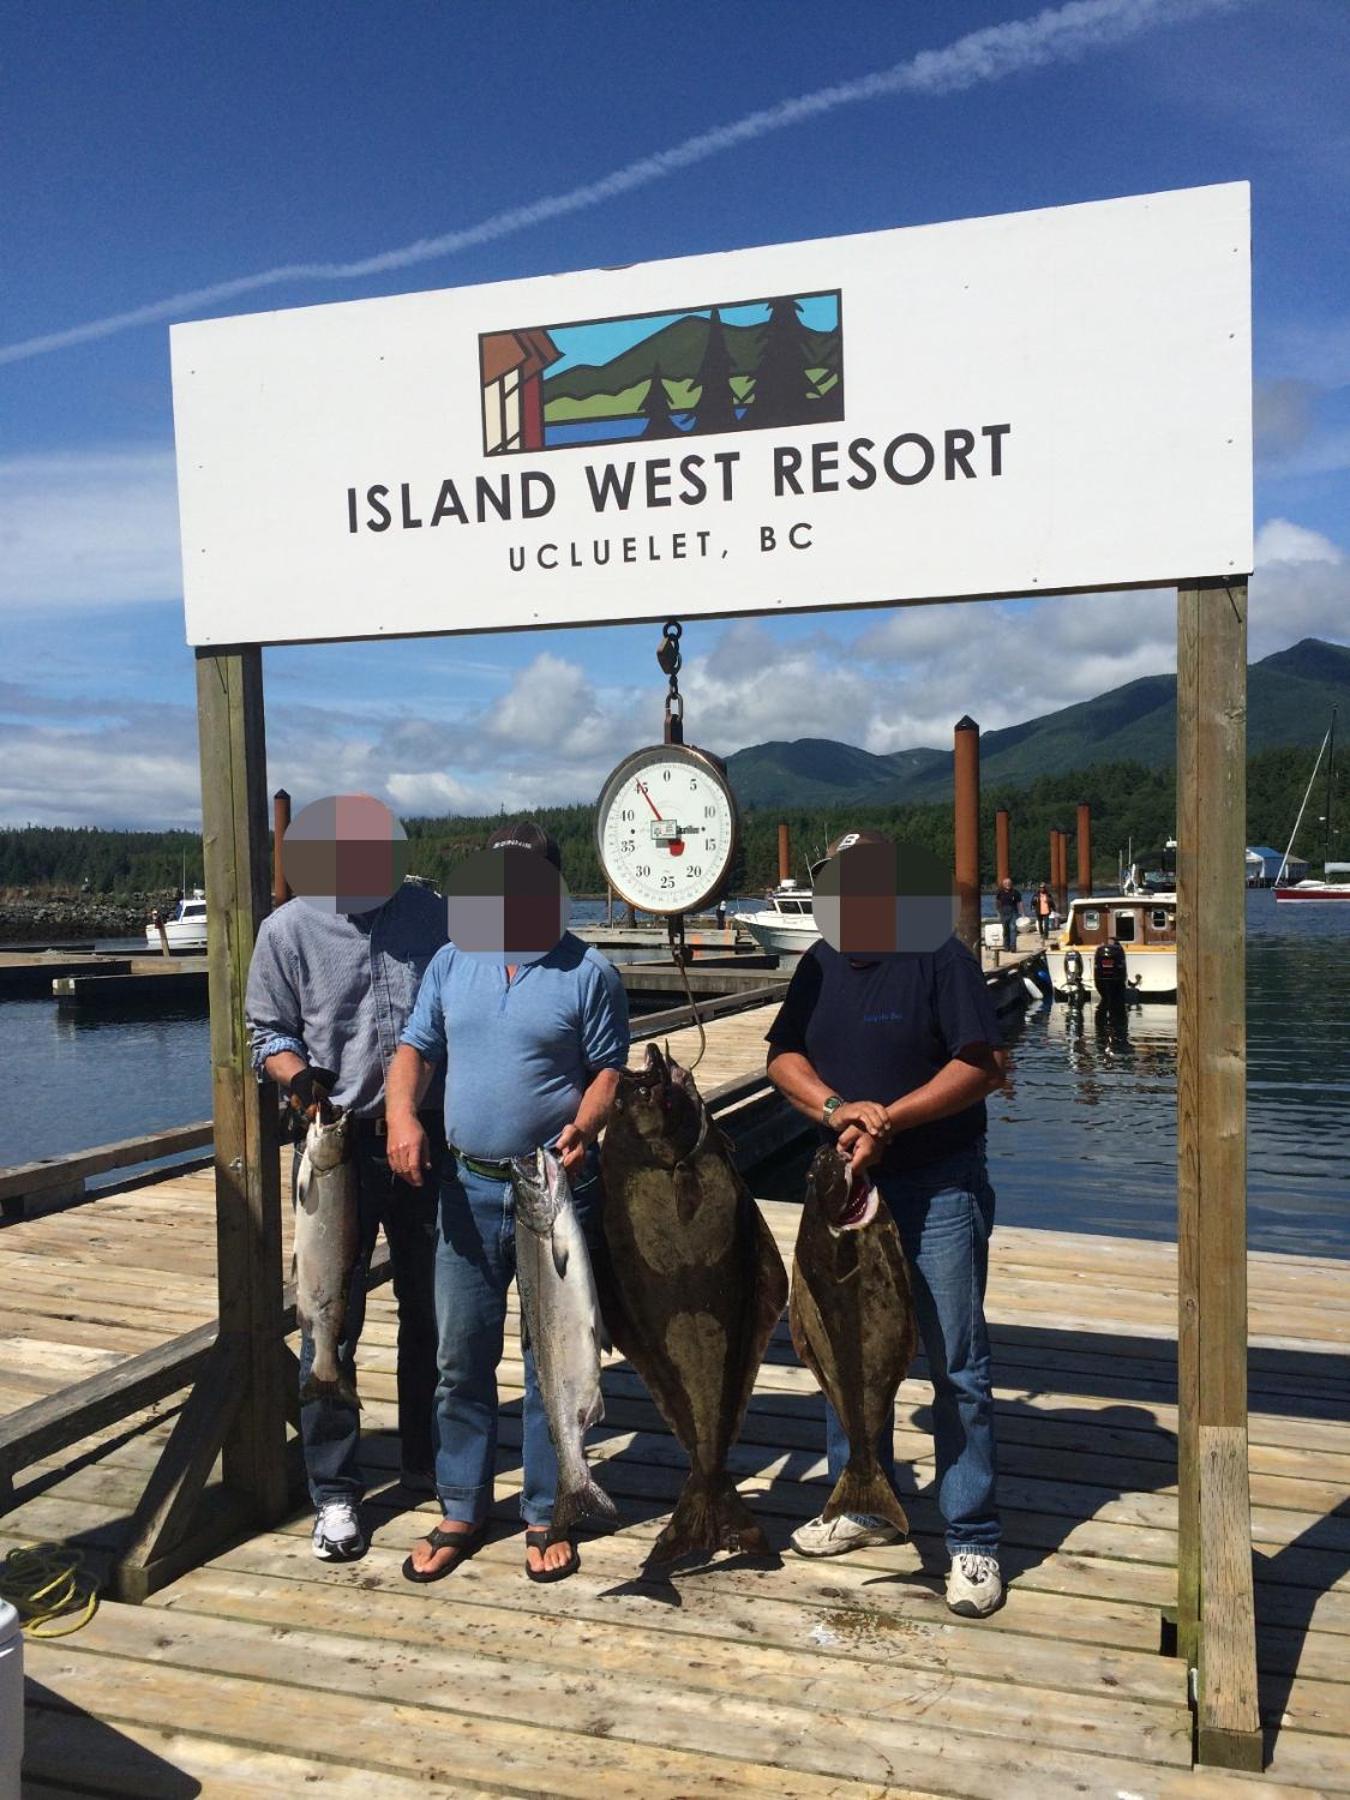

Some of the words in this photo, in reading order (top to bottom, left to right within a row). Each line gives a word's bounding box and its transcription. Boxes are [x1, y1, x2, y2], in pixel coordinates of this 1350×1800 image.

[348, 471, 556, 534] ISLAND
[584, 452, 740, 513] WEST
[773, 423, 1011, 497] RESORT
[509, 530, 729, 573] UCLUELET,
[760, 522, 813, 552] BC
[663, 770, 671, 782] 0
[689, 778, 698, 791] 5
[622, 809, 635, 822] 40
[704, 806, 716, 818] 10
[620, 840, 636, 853] 35
[705, 838, 717, 851] 15
[635, 865, 651, 878] 30
[686, 865, 702, 878] 20
[660, 876, 676, 889] 25
